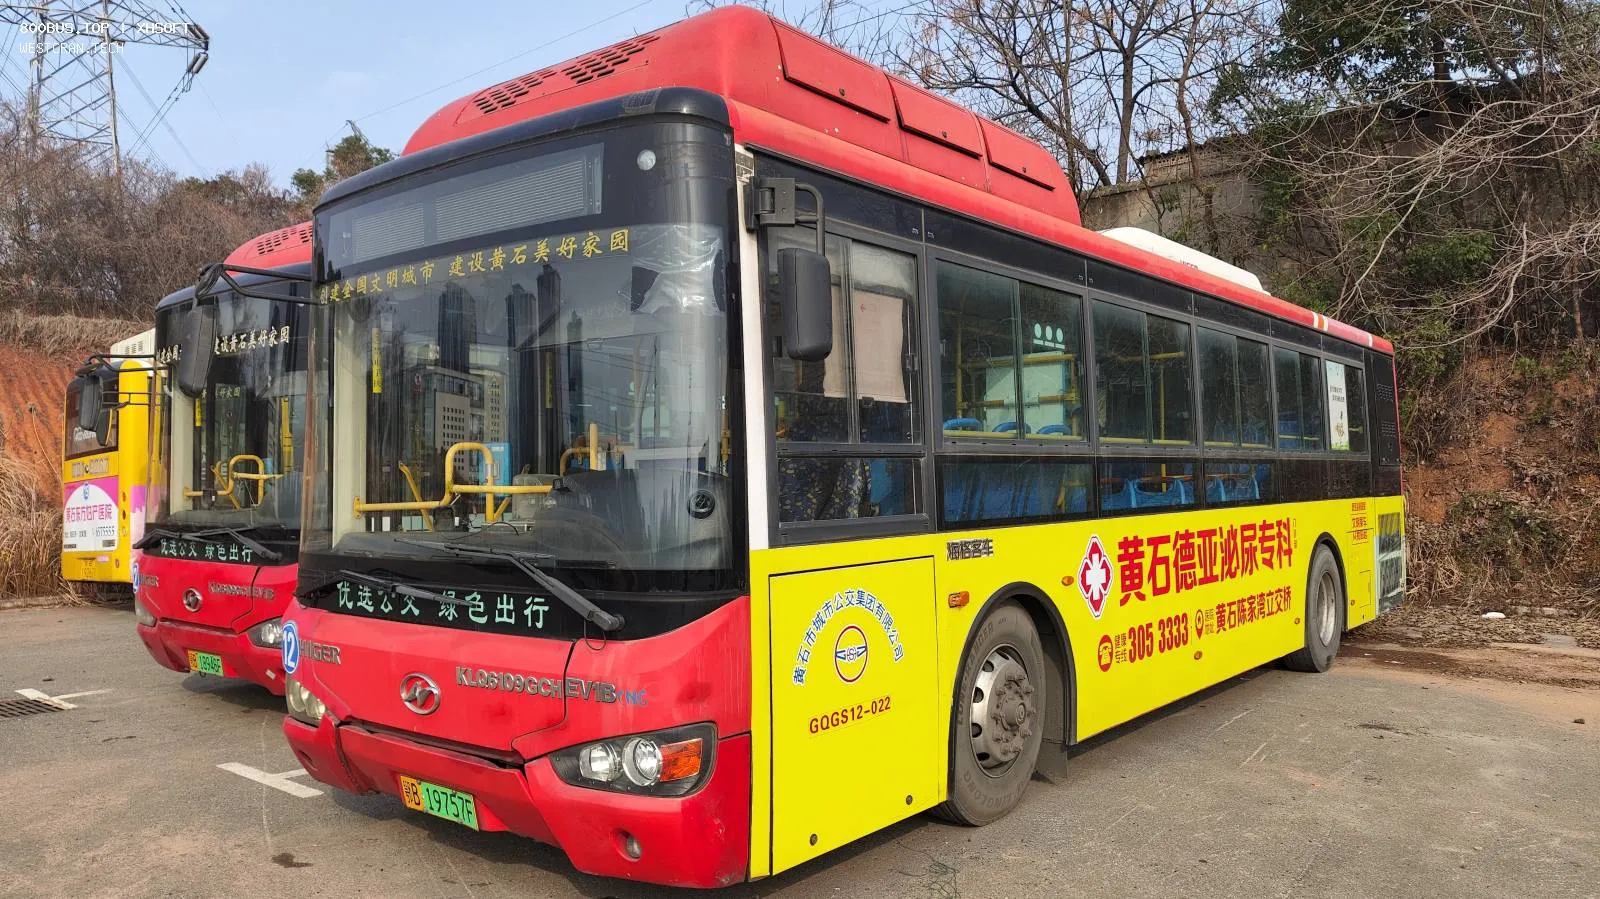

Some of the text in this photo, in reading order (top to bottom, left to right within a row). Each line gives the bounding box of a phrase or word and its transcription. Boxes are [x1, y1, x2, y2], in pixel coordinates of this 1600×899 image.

[320, 228, 630, 304] 创建全国文明城市 建设黄石美好家园
[205, 543, 252, 562] 绿色出行
[946, 538, 994, 561] 海格客车
[1117, 517, 1293, 607] 黄石德亚泌尿专科
[336, 581, 549, 629] 优选公交 绿色出行
[1215, 586, 1292, 634] 黄石陈家湾立交桥
[284, 629, 297, 669] 12
[299, 639, 341, 665] HIGER
[793, 589, 904, 684] 黄石市城市公交集团有限公司
[1128, 612, 1189, 664] 305 3333
[456, 666, 617, 703] KLQ6109GCHEV1B
[809, 695, 892, 734] GQGS12-022
[402, 780, 473, 823] 鄂B 19757F
